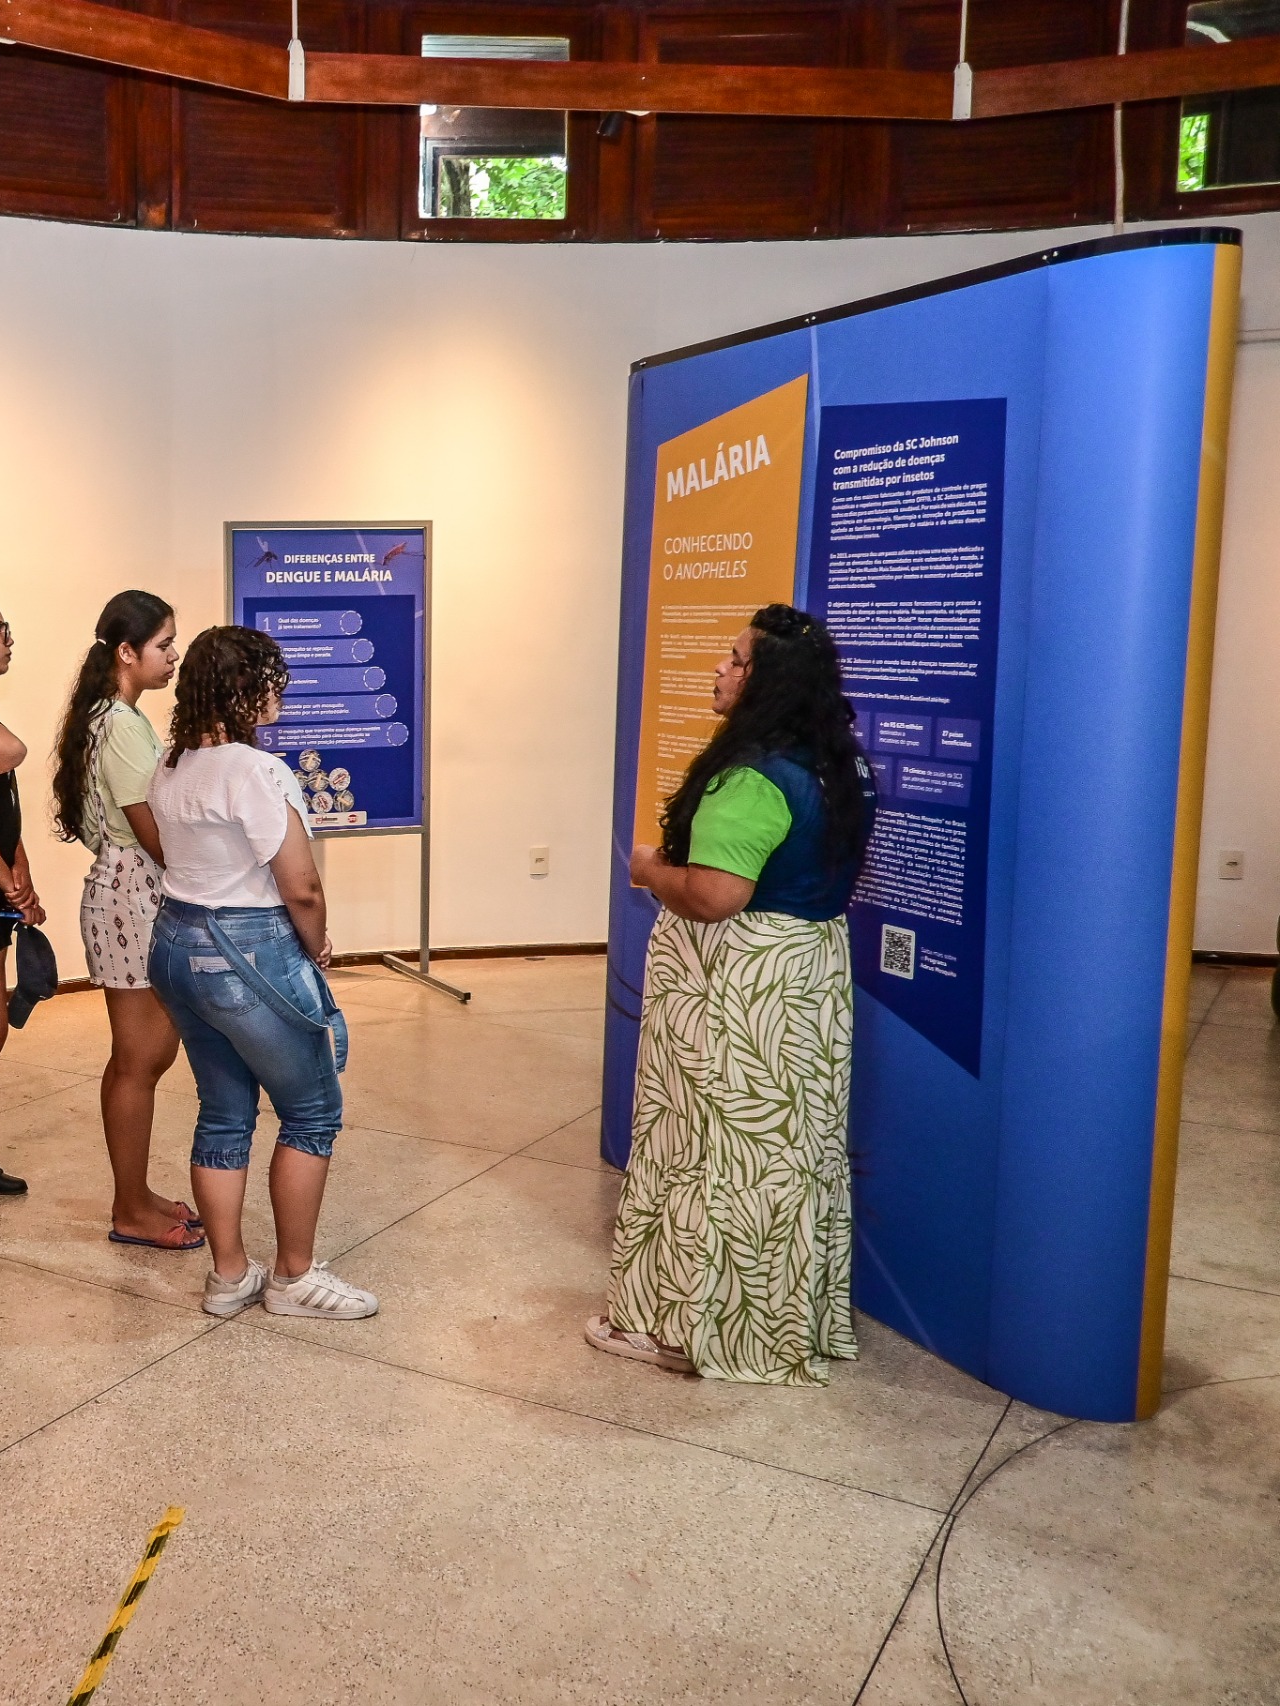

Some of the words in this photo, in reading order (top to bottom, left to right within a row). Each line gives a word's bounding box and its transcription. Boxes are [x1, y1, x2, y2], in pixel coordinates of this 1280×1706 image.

[834, 444, 892, 460] Compromisso
[893, 441, 904, 452] da
[905, 439, 918, 450] SC
[919, 434, 959, 449] Johnson
[666, 434, 771, 502] MALÁRIA
[833, 463, 851, 475] com
[852, 463, 858, 473] a
[859, 458, 894, 473] redução
[895, 457, 906, 467] de
[907, 452, 945, 467] doenças
[833, 474, 884, 491] transmitidas
[885, 475, 901, 487] por
[902, 470, 935, 483] insetos
[664, 532, 753, 554] CONHECENDO
[284, 554, 343, 565] DIFERENÇAS
[345, 554, 376, 563] ENTRE
[266, 570, 321, 583] DENGUE
[324, 570, 332, 582] E
[334, 568, 392, 582] MALÁRIA
[664, 564, 673, 580] O
[675, 560, 748, 580] ANOPHELES
[263, 617, 272, 632] 1
[264, 732, 272, 746] 5
